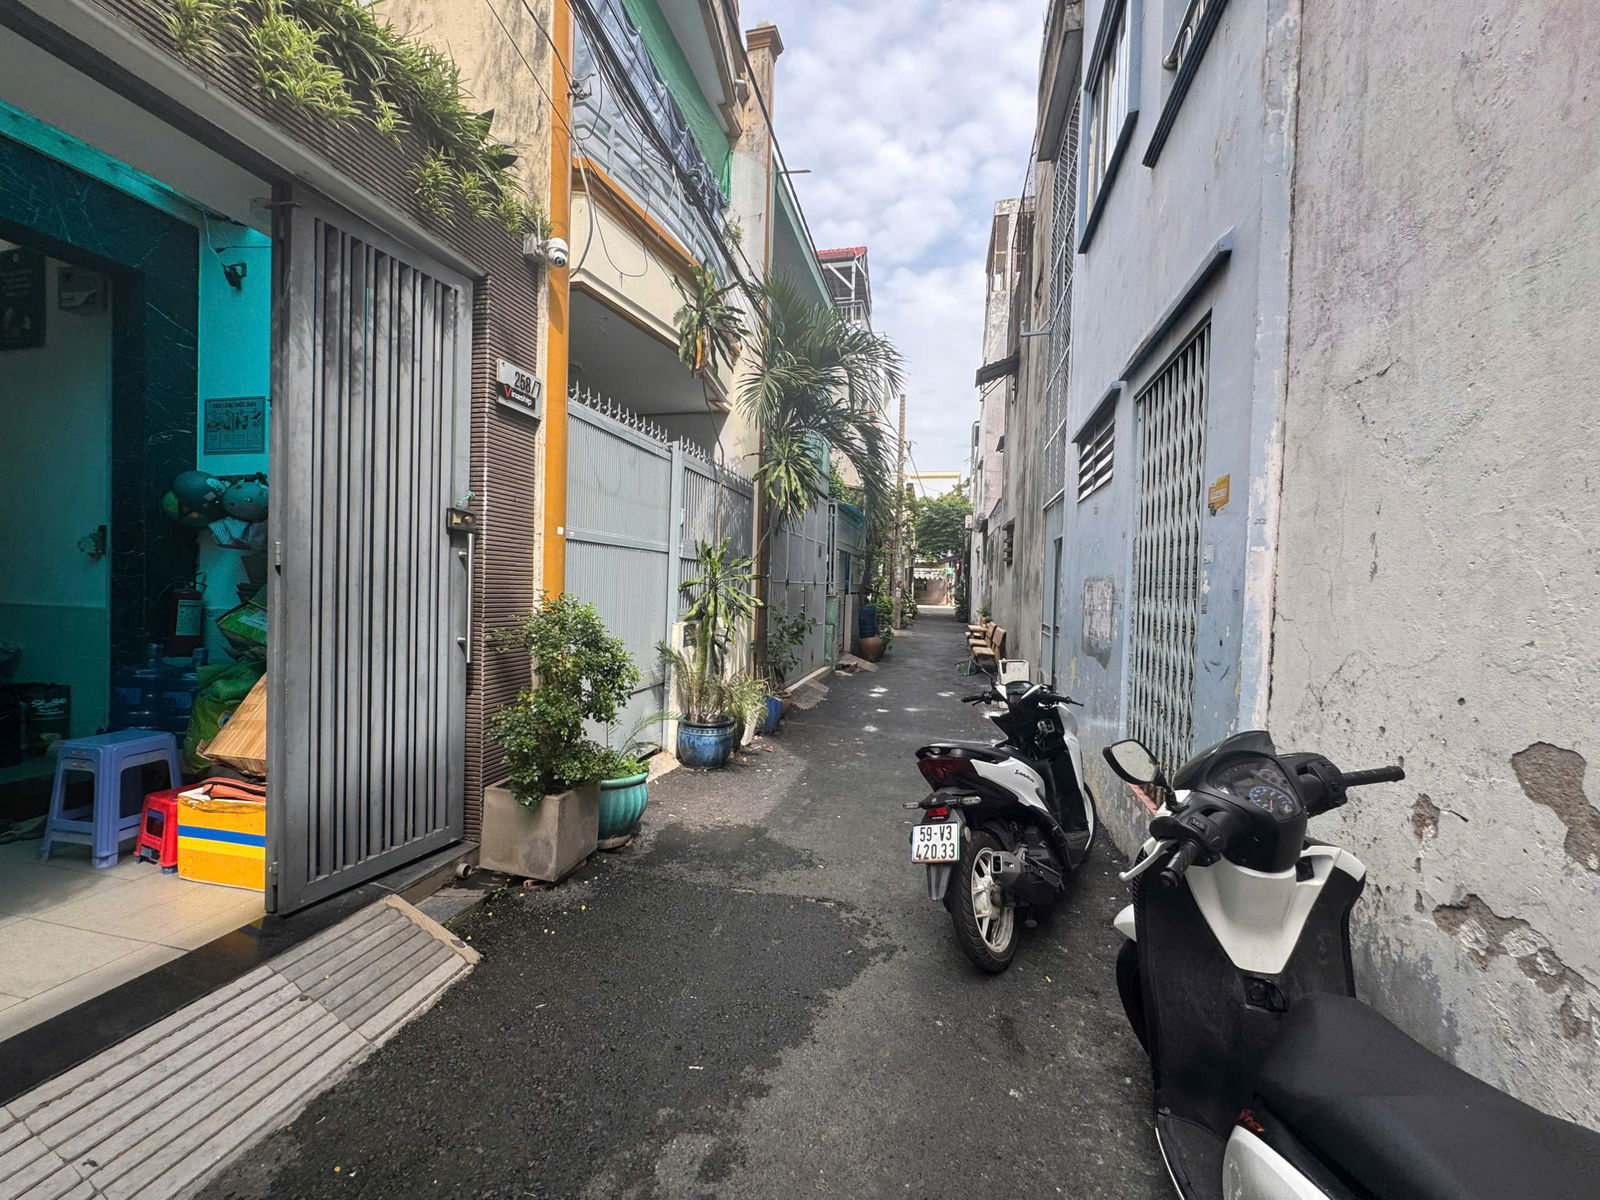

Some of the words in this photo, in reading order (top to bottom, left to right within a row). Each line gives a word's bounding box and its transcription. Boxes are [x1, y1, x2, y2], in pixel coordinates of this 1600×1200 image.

[514, 371, 541, 399] 258/7
[919, 825, 952, 842] 59-V3
[915, 842, 955, 860] 420.33
